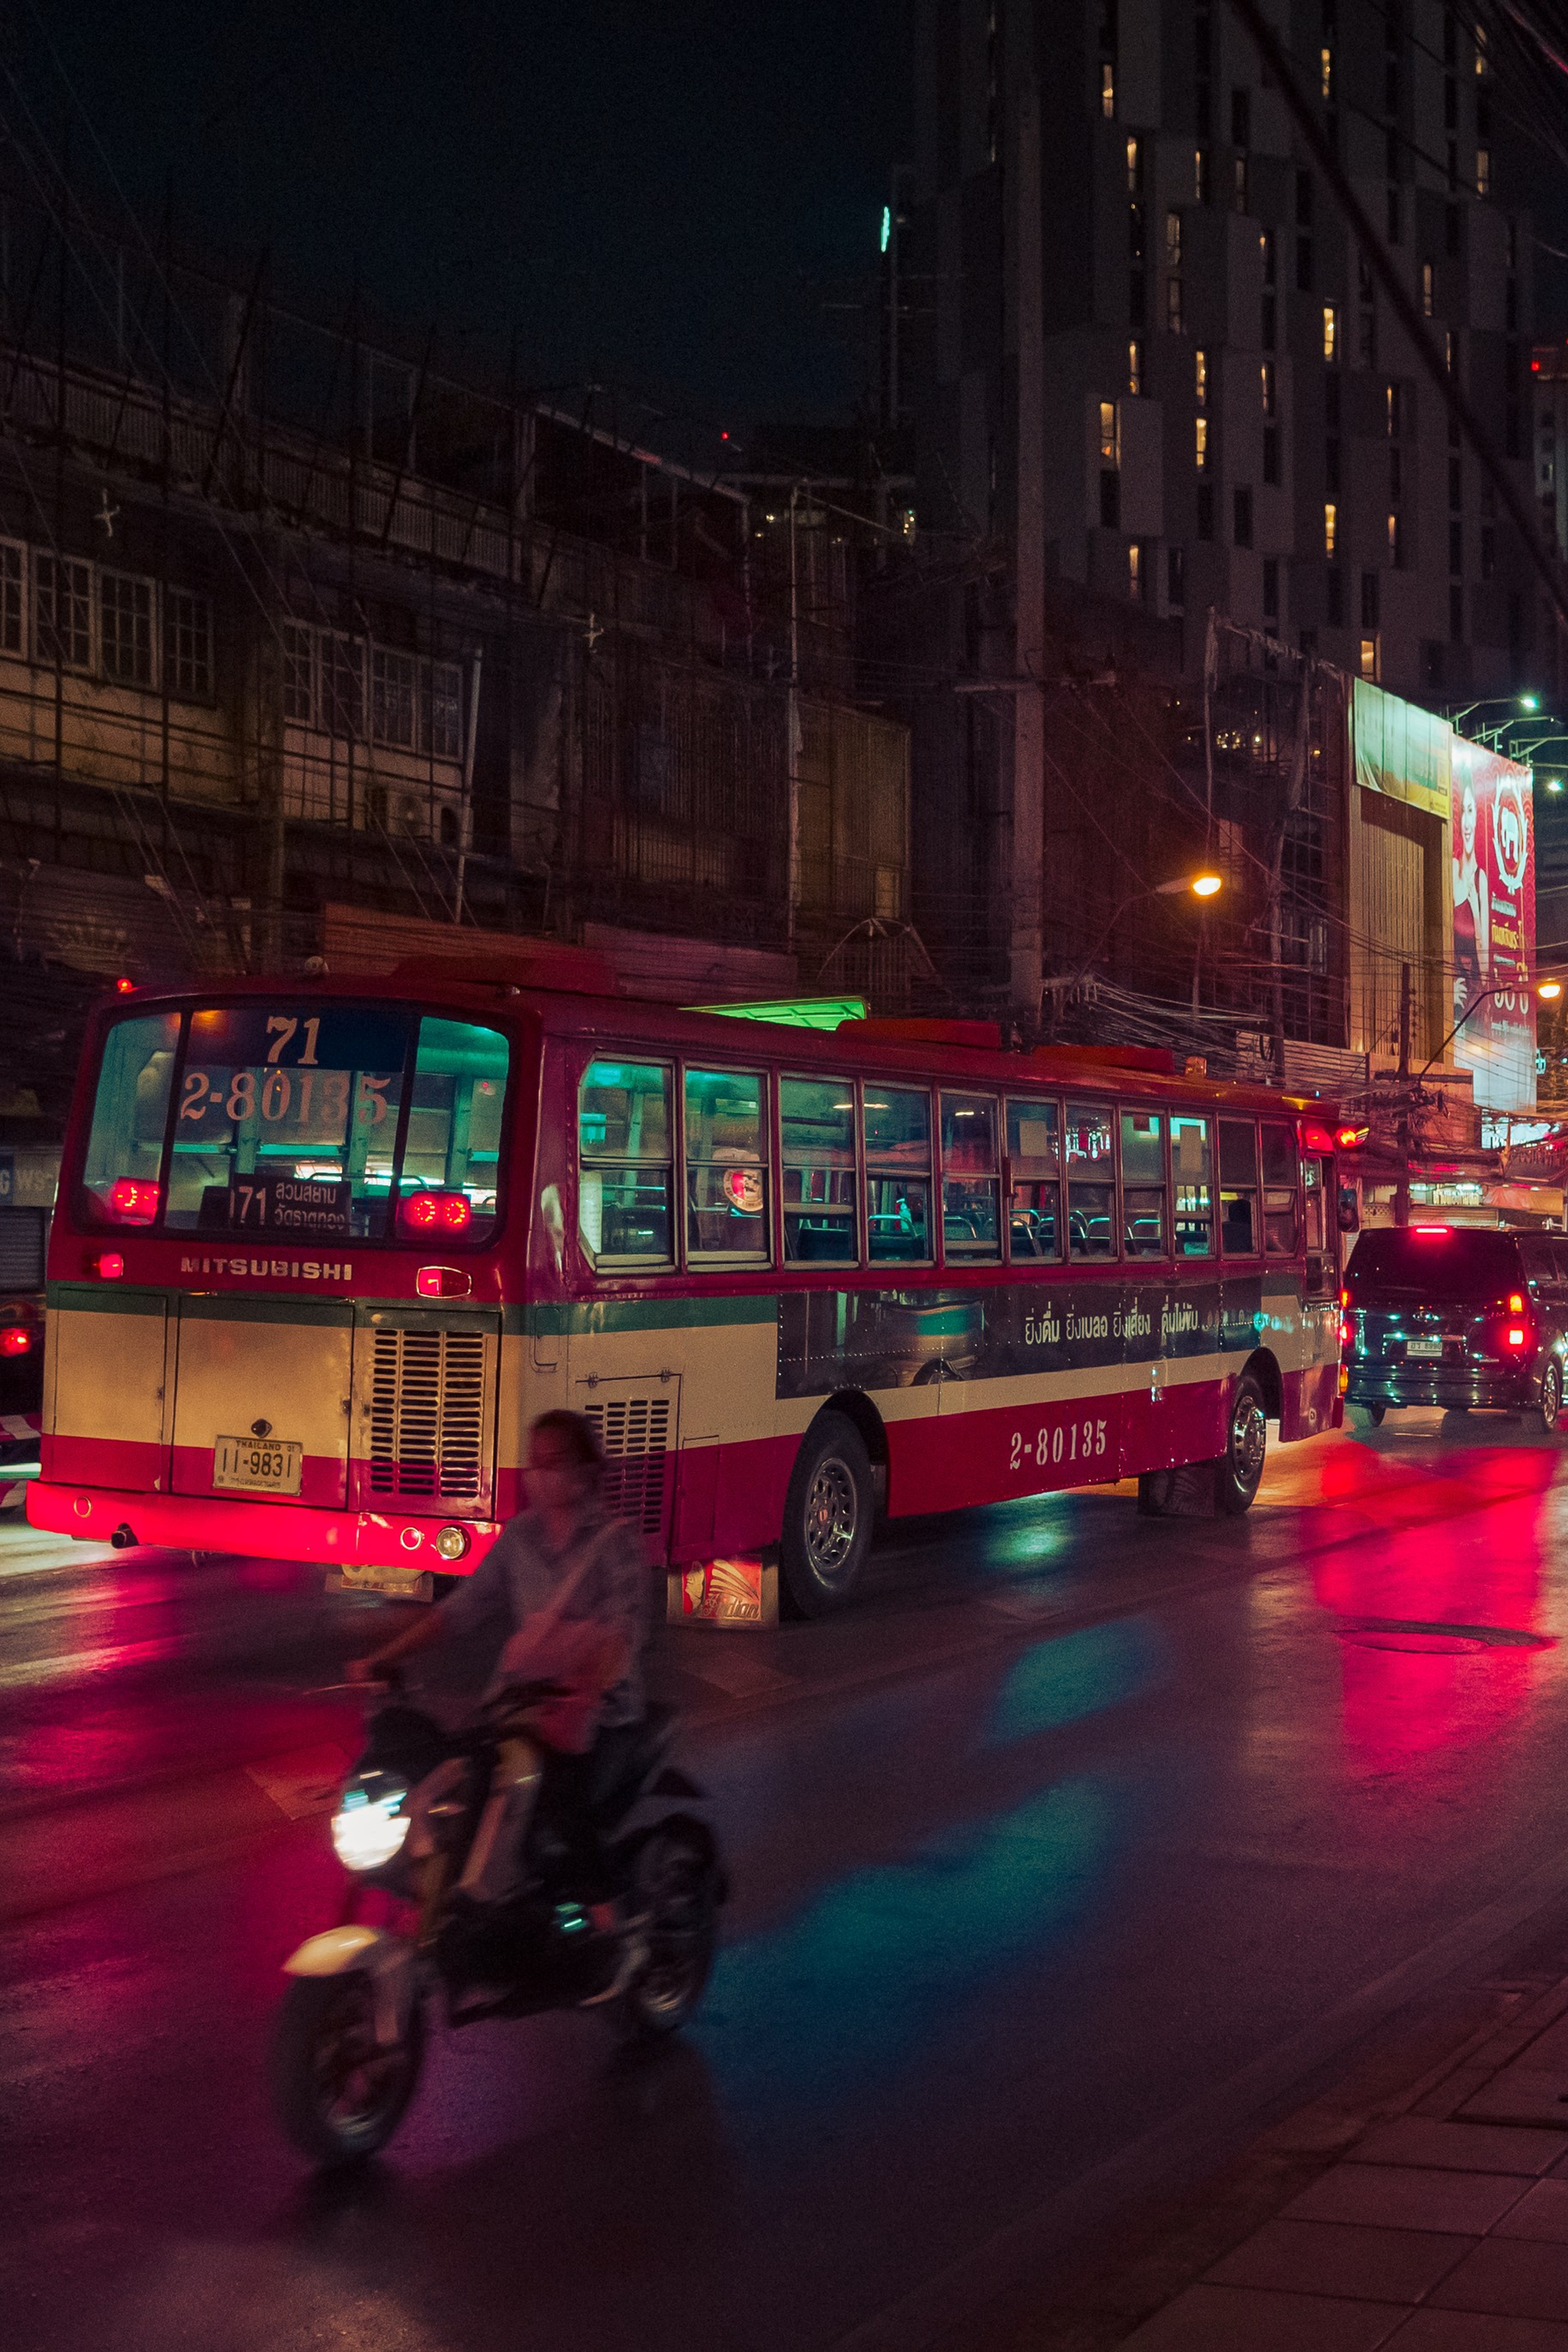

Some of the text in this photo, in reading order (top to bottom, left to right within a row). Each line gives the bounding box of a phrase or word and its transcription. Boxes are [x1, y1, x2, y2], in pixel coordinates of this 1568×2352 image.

[266, 1016, 319, 1065] 71
[180, 1072, 391, 1124] 2-80135
[275, 1182, 336, 1205] สวนสยาม
[181, 1257, 352, 1281] MITSUBISHI
[1066, 1303, 1108, 1340] ยิ่งเบลอ
[236, 1440, 281, 1451] THAILAND
[1009, 1419, 1107, 1470] 2-80135
[222, 1447, 292, 1478] 11-9831
